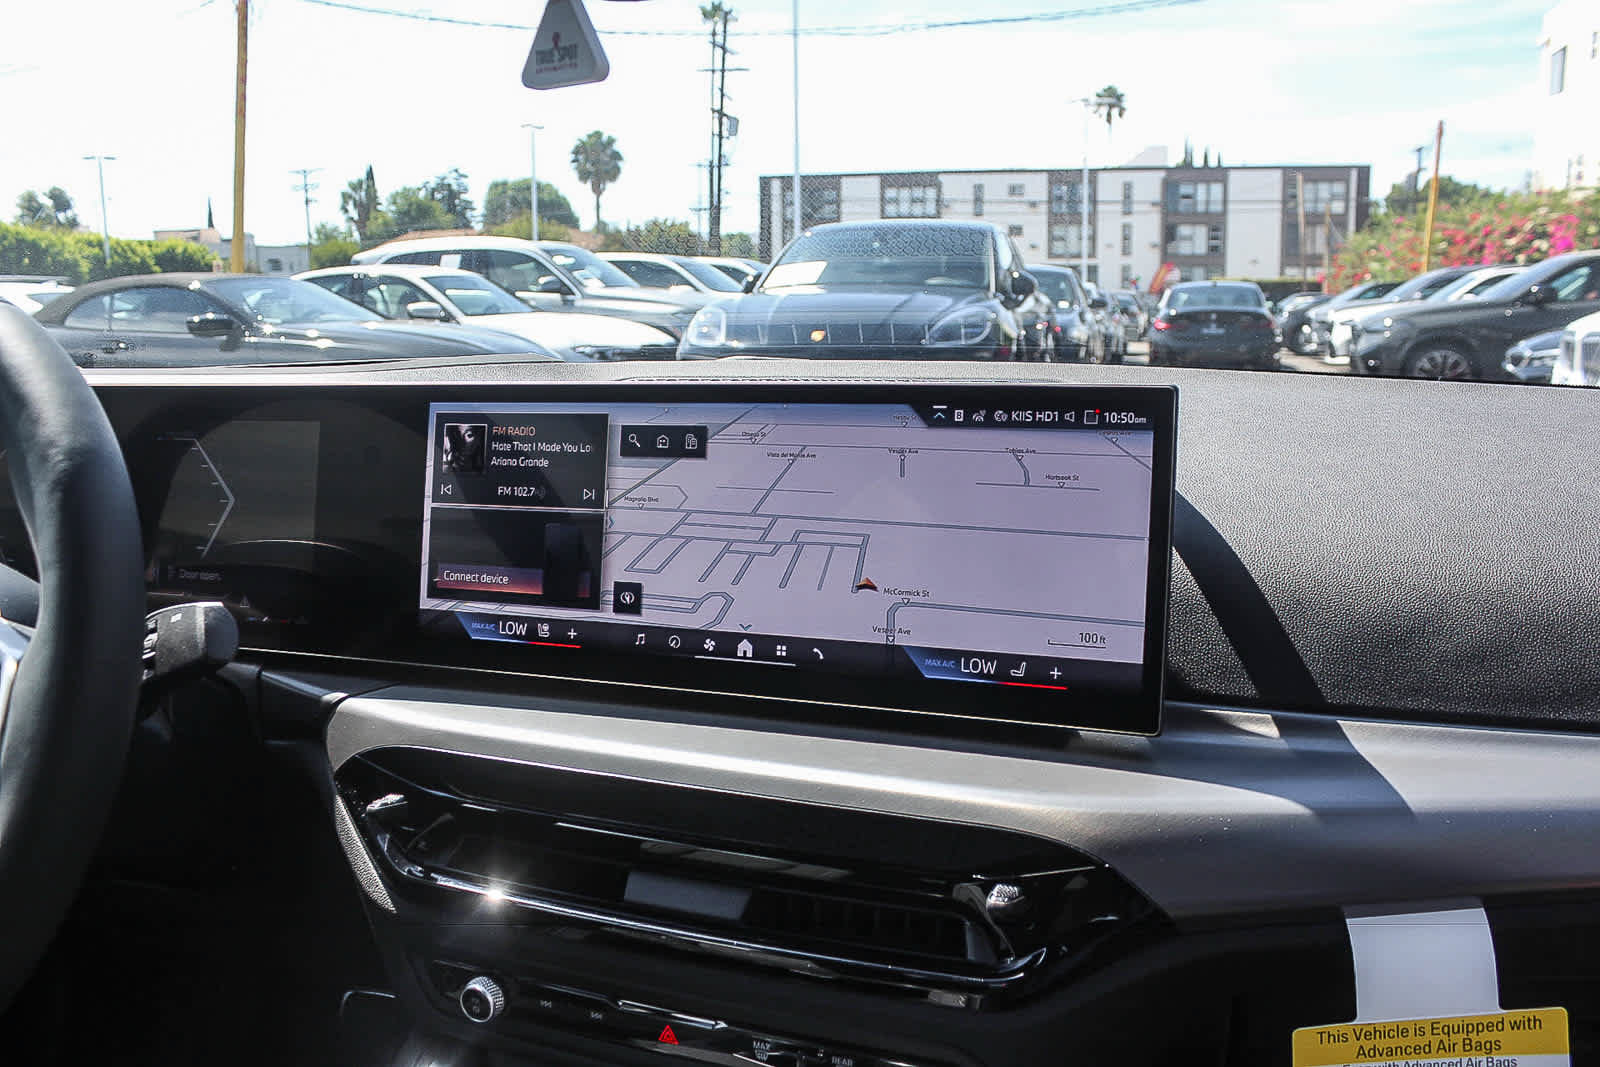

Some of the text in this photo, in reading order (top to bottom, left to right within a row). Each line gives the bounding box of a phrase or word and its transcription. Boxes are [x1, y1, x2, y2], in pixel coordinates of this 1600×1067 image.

[1011, 410, 1059, 422] KIIS HD1
[492, 426, 536, 437] FM RADIO
[491, 441, 512, 452] Hate
[512, 441, 532, 452] That
[537, 442, 561, 453] Made
[562, 442, 578, 453] You
[580, 443, 591, 453] Lo
[490, 456, 550, 468] Ariana Grande
[497, 486, 536, 497] FM 102.7
[443, 570, 510, 585] Connect device
[883, 587, 930, 598] McCormick St
[499, 620, 528, 636] LOW
[897, 627, 912, 636] Ave
[1079, 632, 1106, 645] 100 ft
[960, 656, 998, 675] LOW
[1316, 1015, 1543, 1045] This Vehicle is Equipped with
[1355, 1037, 1503, 1060] Advanced Air Bags
[1465, 1056, 1486, 1067] Air
[1486, 1055, 1519, 1067] Bags
